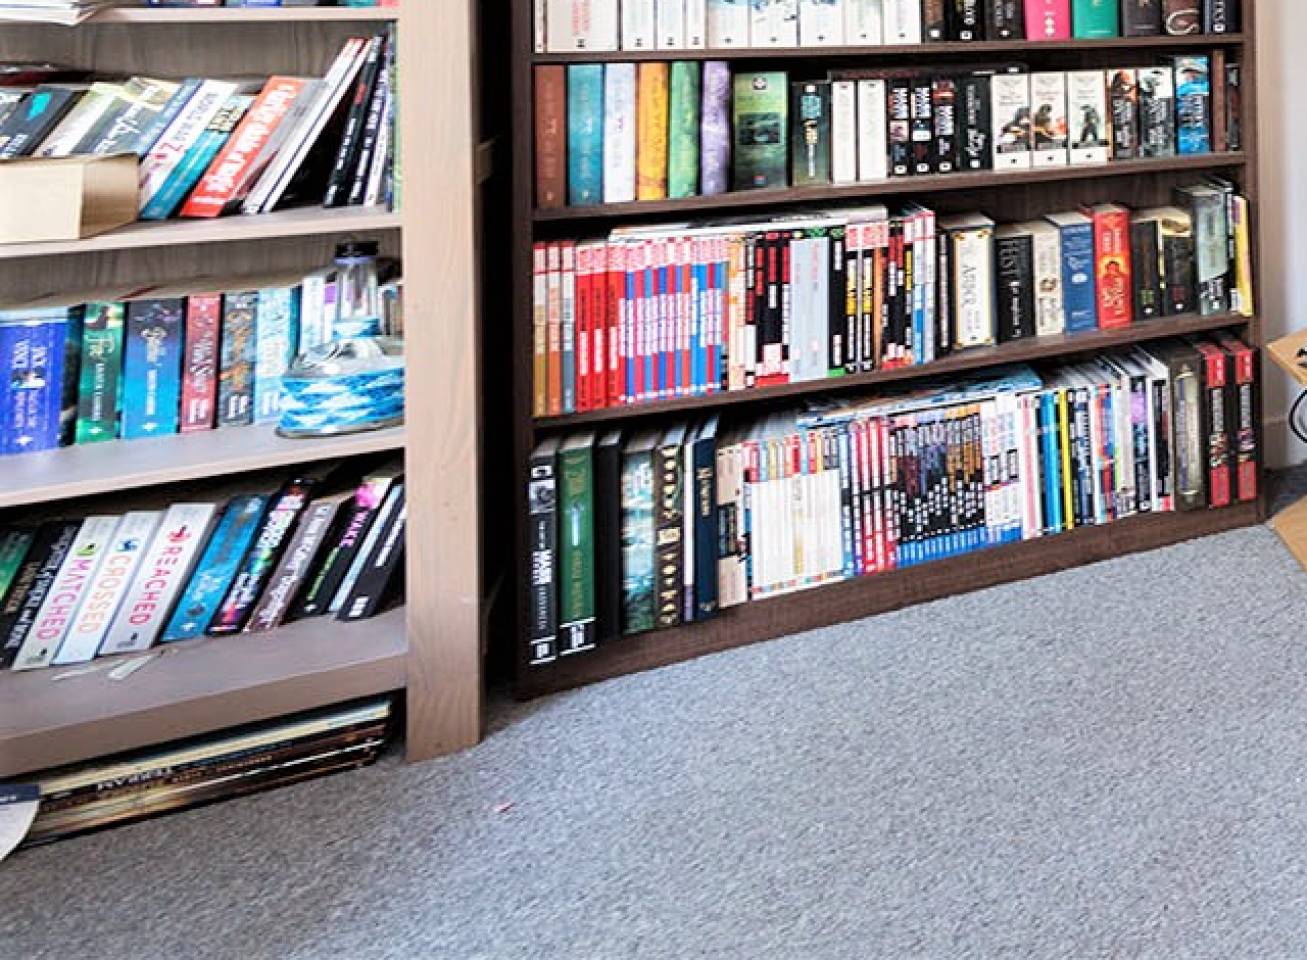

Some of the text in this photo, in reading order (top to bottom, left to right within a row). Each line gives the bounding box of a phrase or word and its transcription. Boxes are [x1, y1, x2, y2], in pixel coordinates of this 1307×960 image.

[339, 510, 369, 548] WAKE
[36, 558, 94, 642] MATCHED
[77, 553, 133, 635] CROSSED
[127, 545, 183, 627] REACHED
